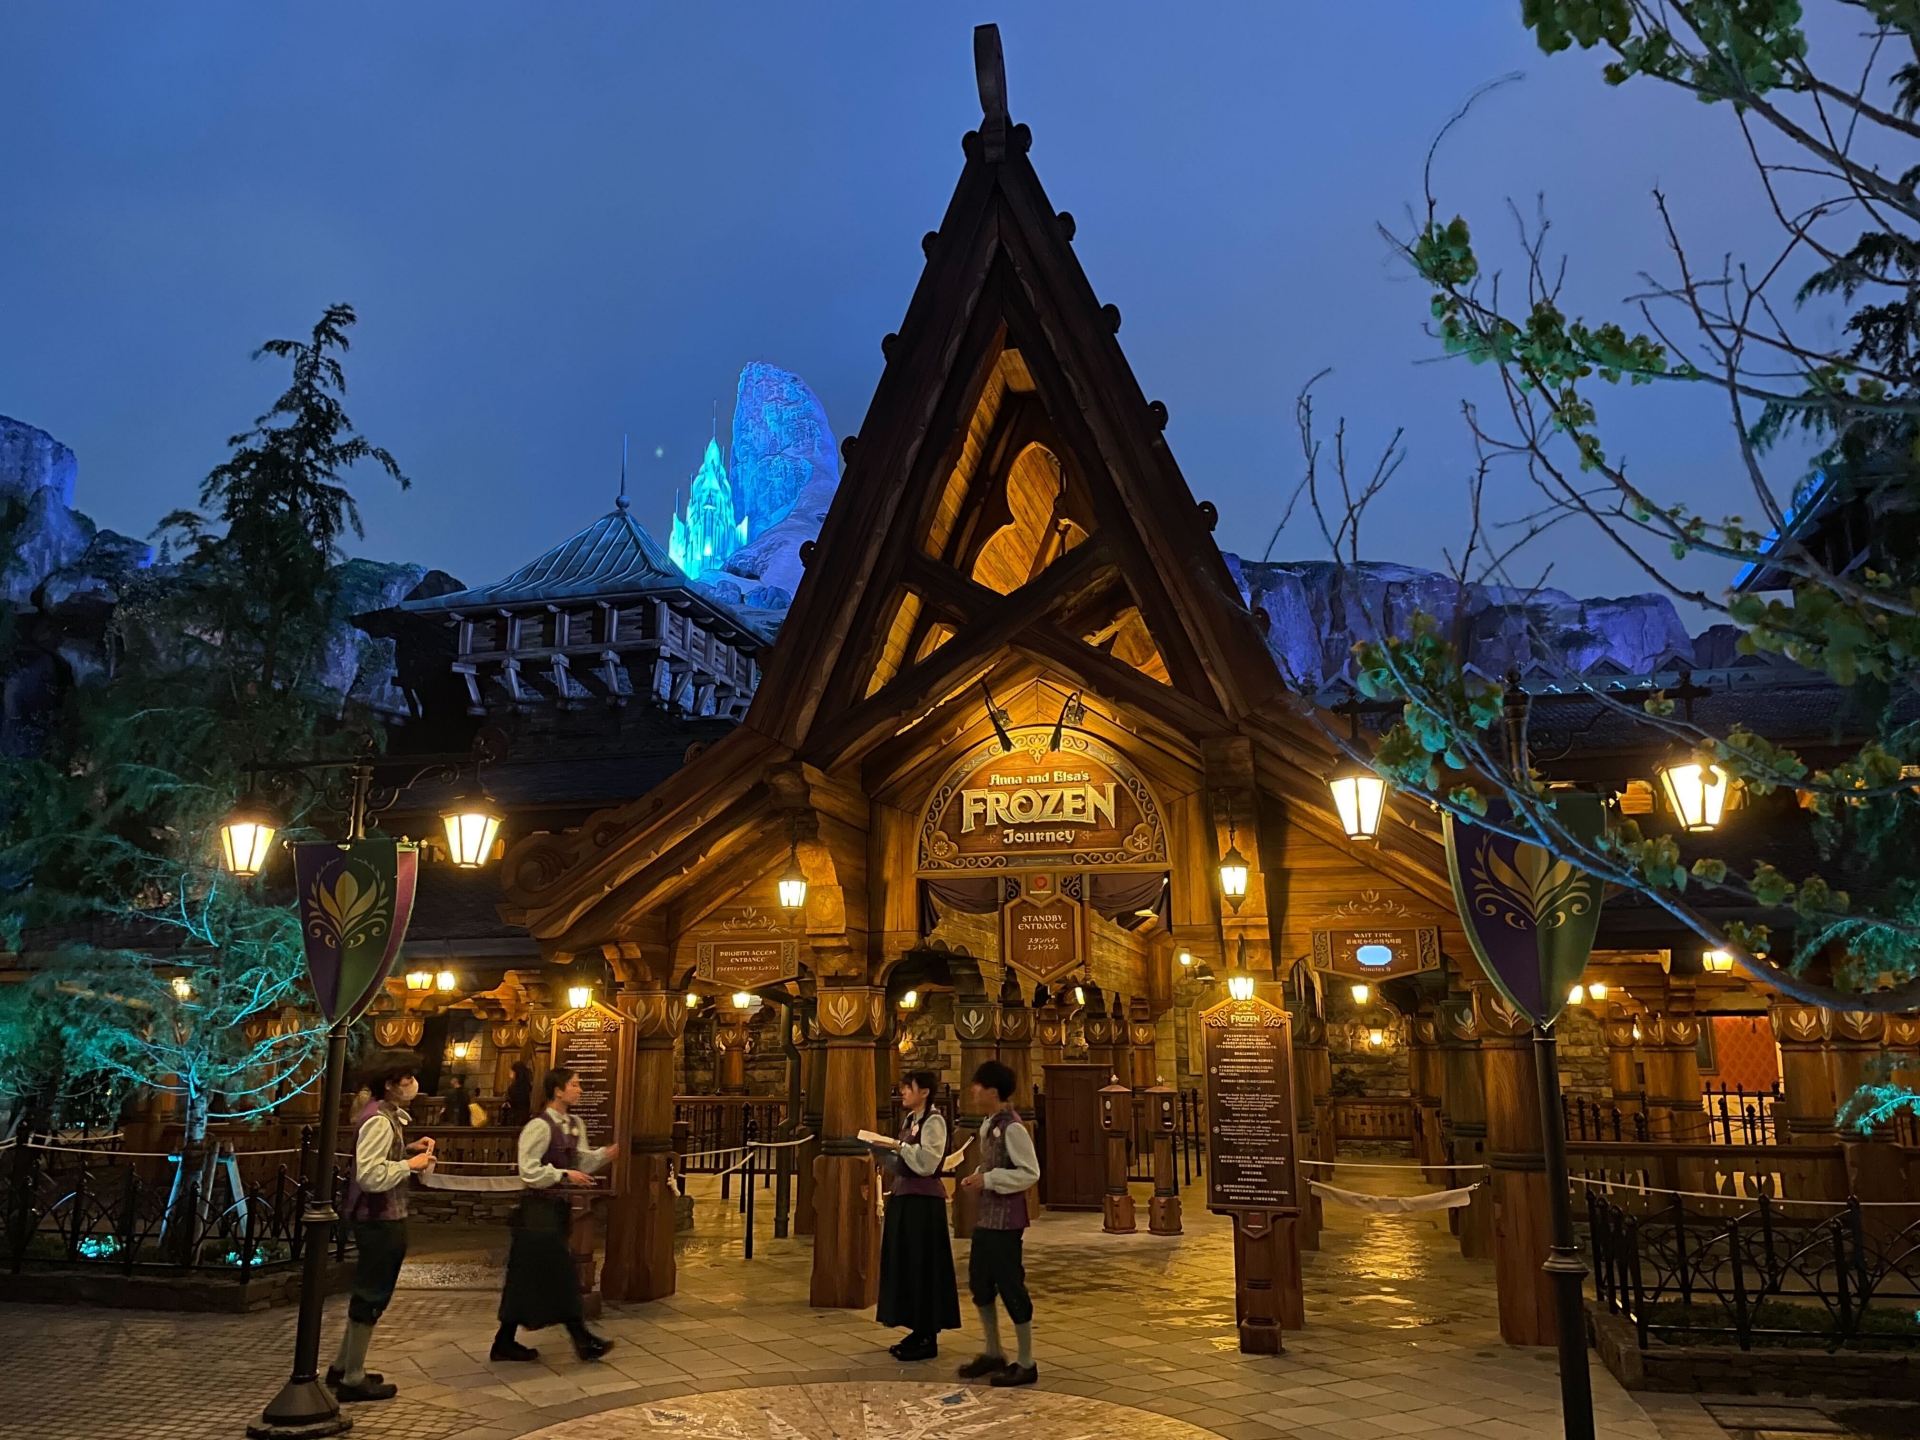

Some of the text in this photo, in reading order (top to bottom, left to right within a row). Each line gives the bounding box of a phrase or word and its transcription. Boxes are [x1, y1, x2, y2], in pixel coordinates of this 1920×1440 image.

[989, 770, 1090, 786] Anna and Elsa's
[961, 782, 1116, 833] FROZEN
[1002, 829, 1076, 844] Journey
[1022, 914, 1063, 922] STANDBY
[1018, 922, 1067, 930] ENTRANCE
[1026, 943, 1060, 951] エントランス
[1230, 1014, 1260, 1024] FROZEN
[577, 1021, 601, 1029] FROZEN
